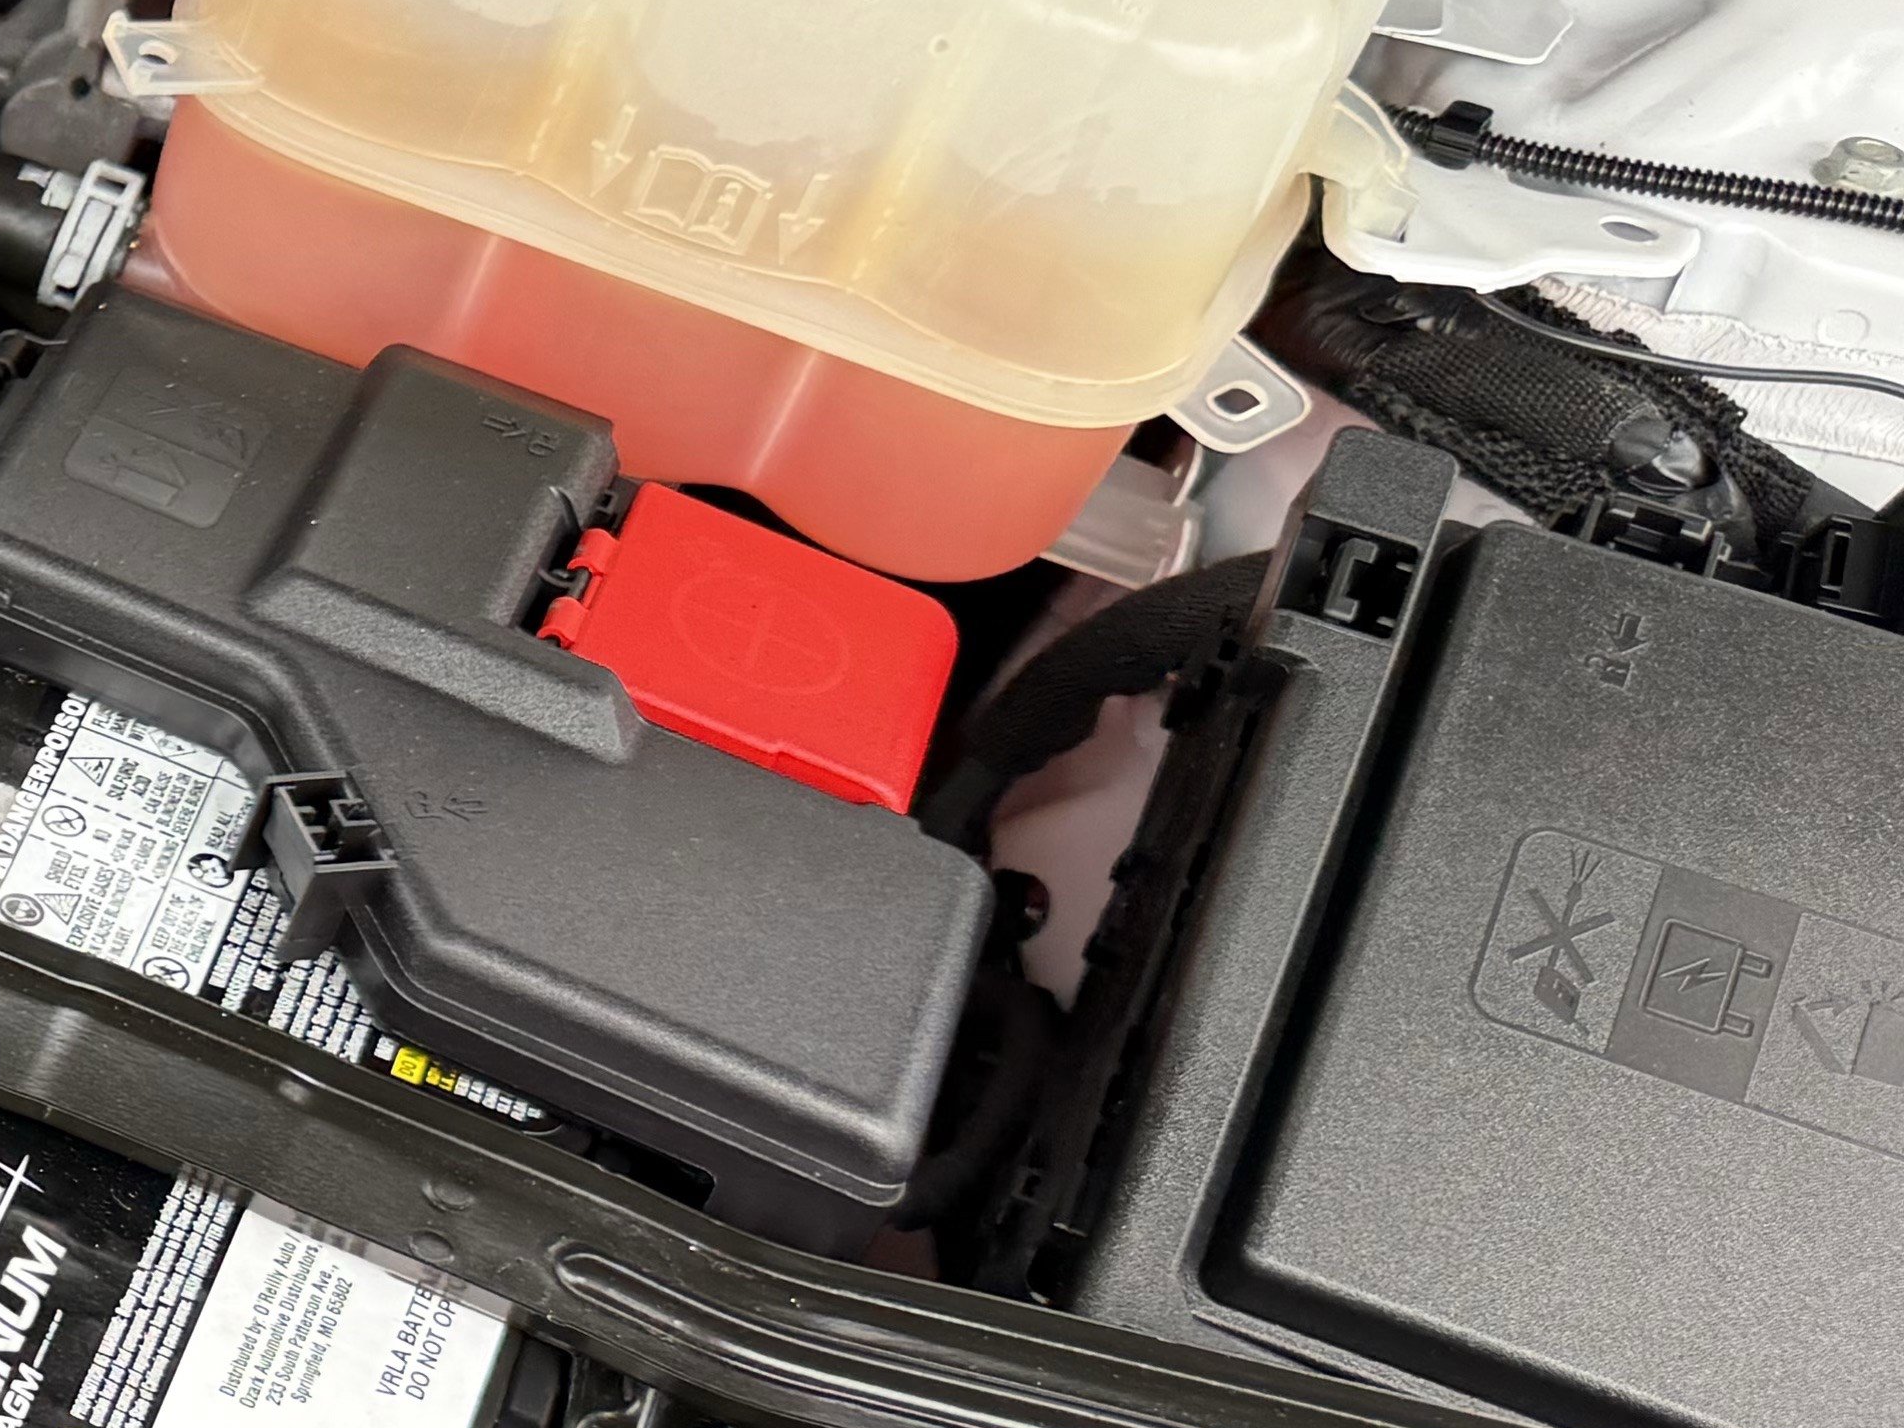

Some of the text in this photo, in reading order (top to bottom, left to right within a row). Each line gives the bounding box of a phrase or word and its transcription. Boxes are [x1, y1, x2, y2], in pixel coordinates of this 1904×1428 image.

[128, 772, 153, 799] ACID
[43, 847, 74, 885] SHIELD
[64, 894, 103, 950] EXPLOSIVE
[87, 864, 116, 899] GASES
[149, 891, 187, 952] KEEP OUT OF
[165, 935, 188, 958] THE
[186, 892, 207, 911] OF
[267, 1236, 298, 1269] Auto
[237, 1237, 324, 1410] Ozark Automotive Distributors,
[248, 1265, 289, 1318] O'Reilly
[217, 1332, 260, 1398] Distributed
[263, 1258, 340, 1407] 233 South Patterson Ave.,
[286, 1275, 355, 1406] Springfield, MO 65802
[373, 1283, 438, 1399] VRLA BATTE
[402, 1295, 461, 1401] DO NOT OP
